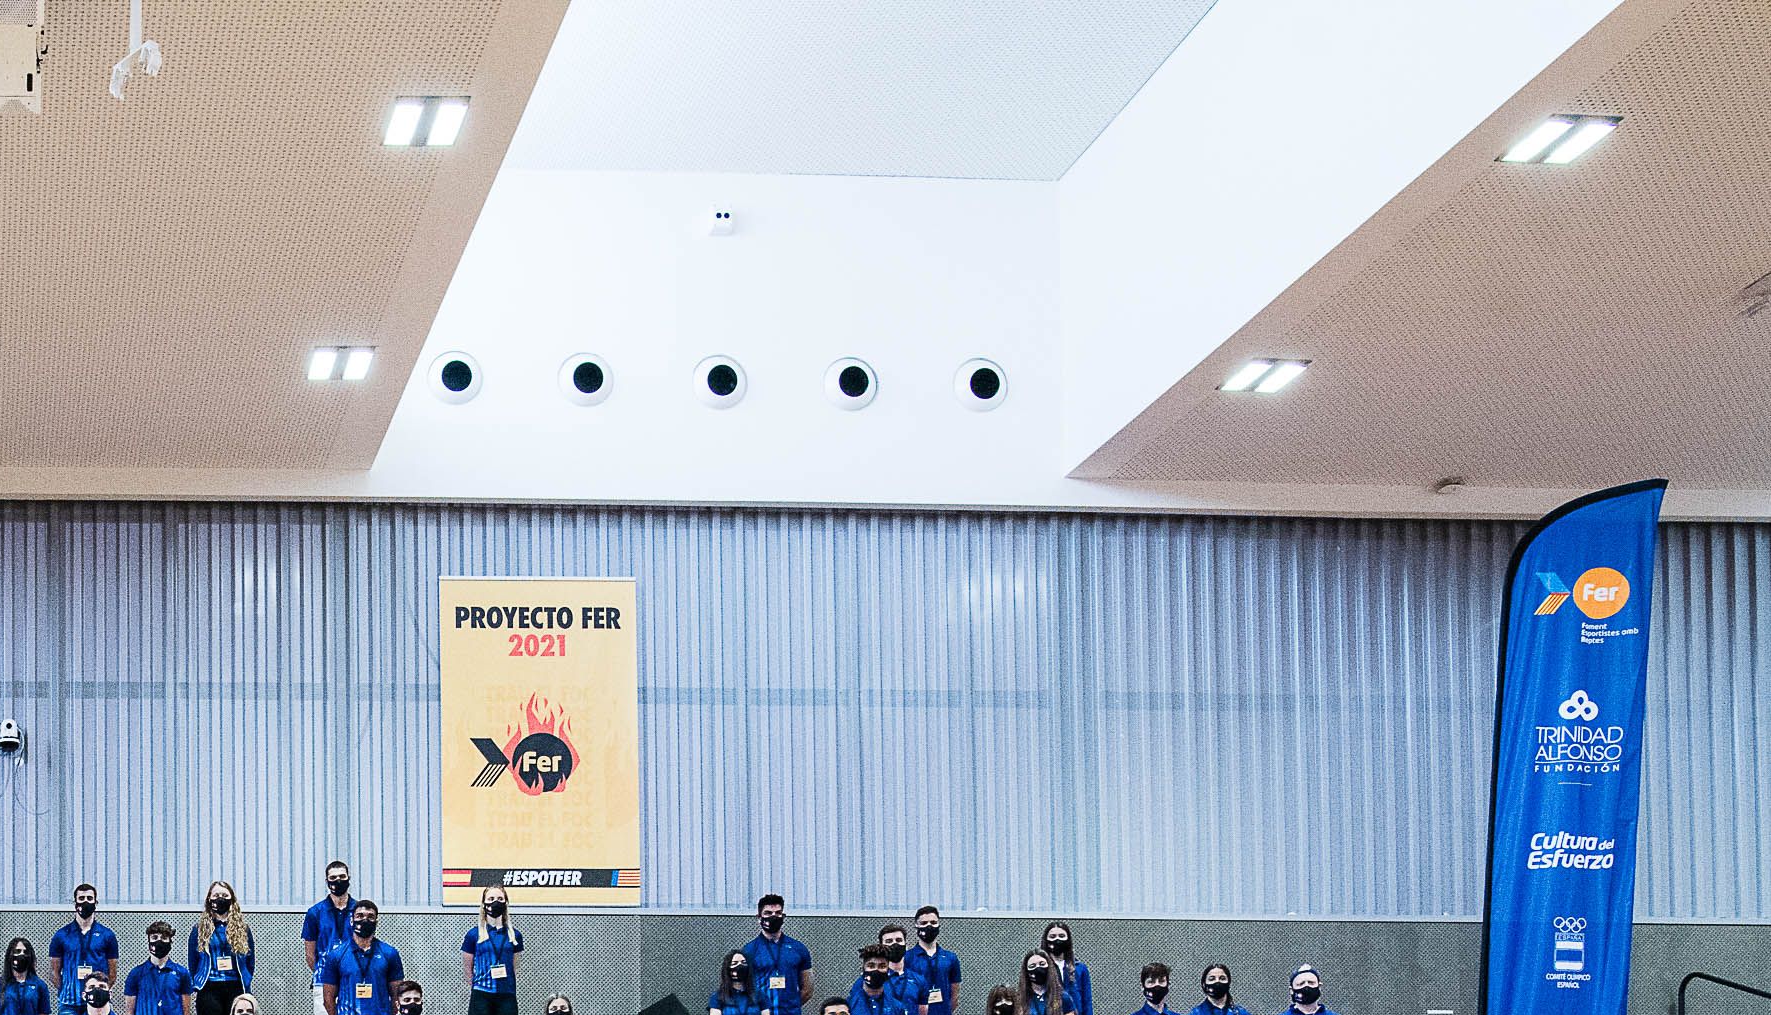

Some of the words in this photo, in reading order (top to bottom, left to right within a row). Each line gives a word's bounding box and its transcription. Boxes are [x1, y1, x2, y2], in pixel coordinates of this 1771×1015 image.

[1582, 583, 1619, 602] Fer
[455, 606, 573, 629] PROYECTO
[582, 606, 621, 629] FER
[508, 634, 566, 657] 2021
[1535, 726, 1624, 744] TRINIDAD
[522, 751, 562, 773] Fer
[1535, 744, 1622, 761] ALFONSO
[1534, 762, 1620, 773] FUNDACIÓN
[1530, 831, 1598, 851] Cultura
[1598, 838, 1615, 850] del
[1527, 849, 1614, 870] Esfuerzo
[502, 869, 582, 886] #ESPOTFER
